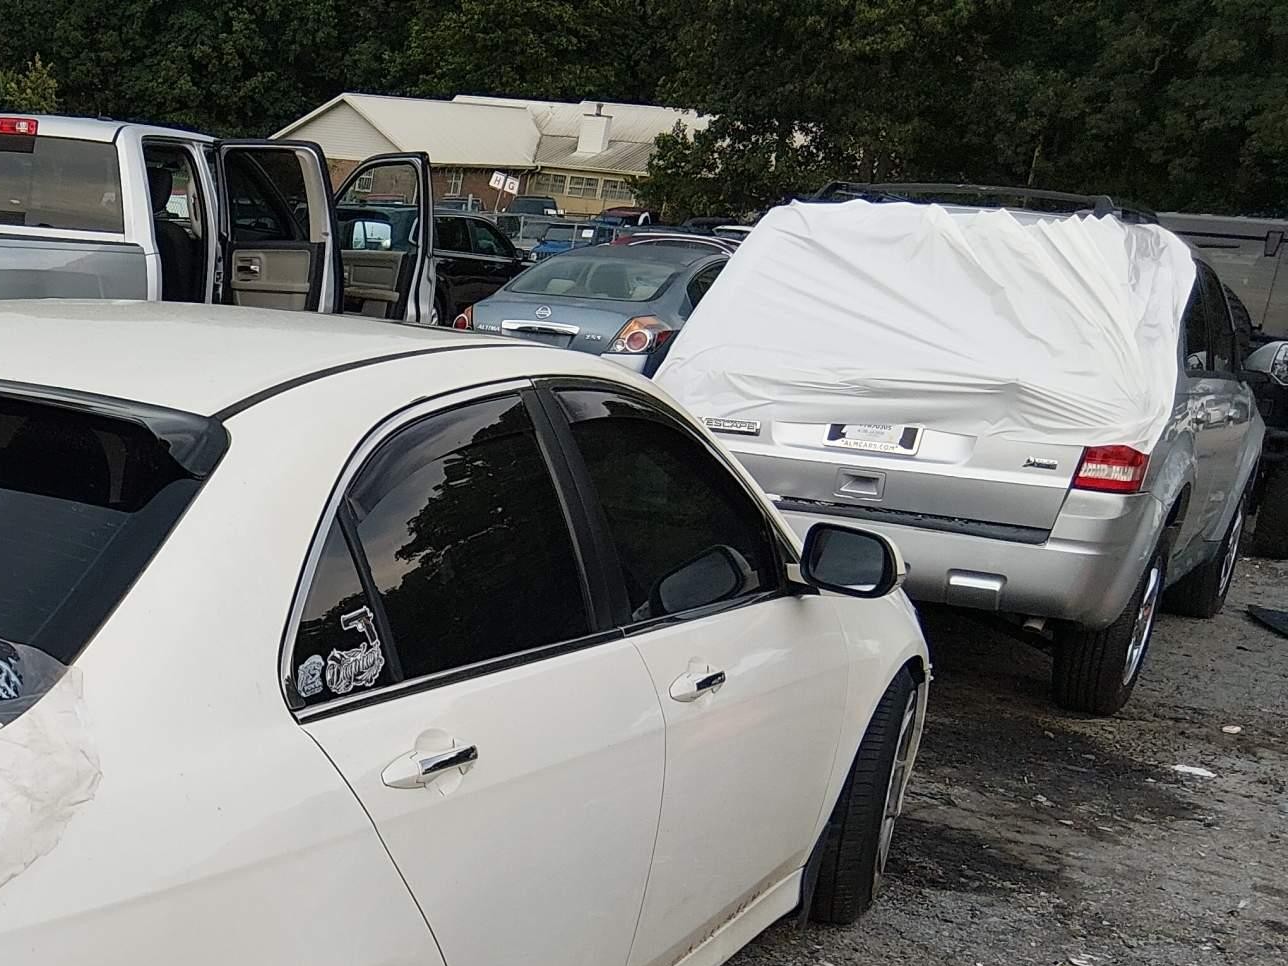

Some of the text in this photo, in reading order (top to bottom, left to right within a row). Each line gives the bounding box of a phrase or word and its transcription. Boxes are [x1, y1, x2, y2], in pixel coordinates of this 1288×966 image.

[493, 175, 502, 186] H
[508, 181, 516, 190] G
[705, 417, 757, 430] ESCAPE
